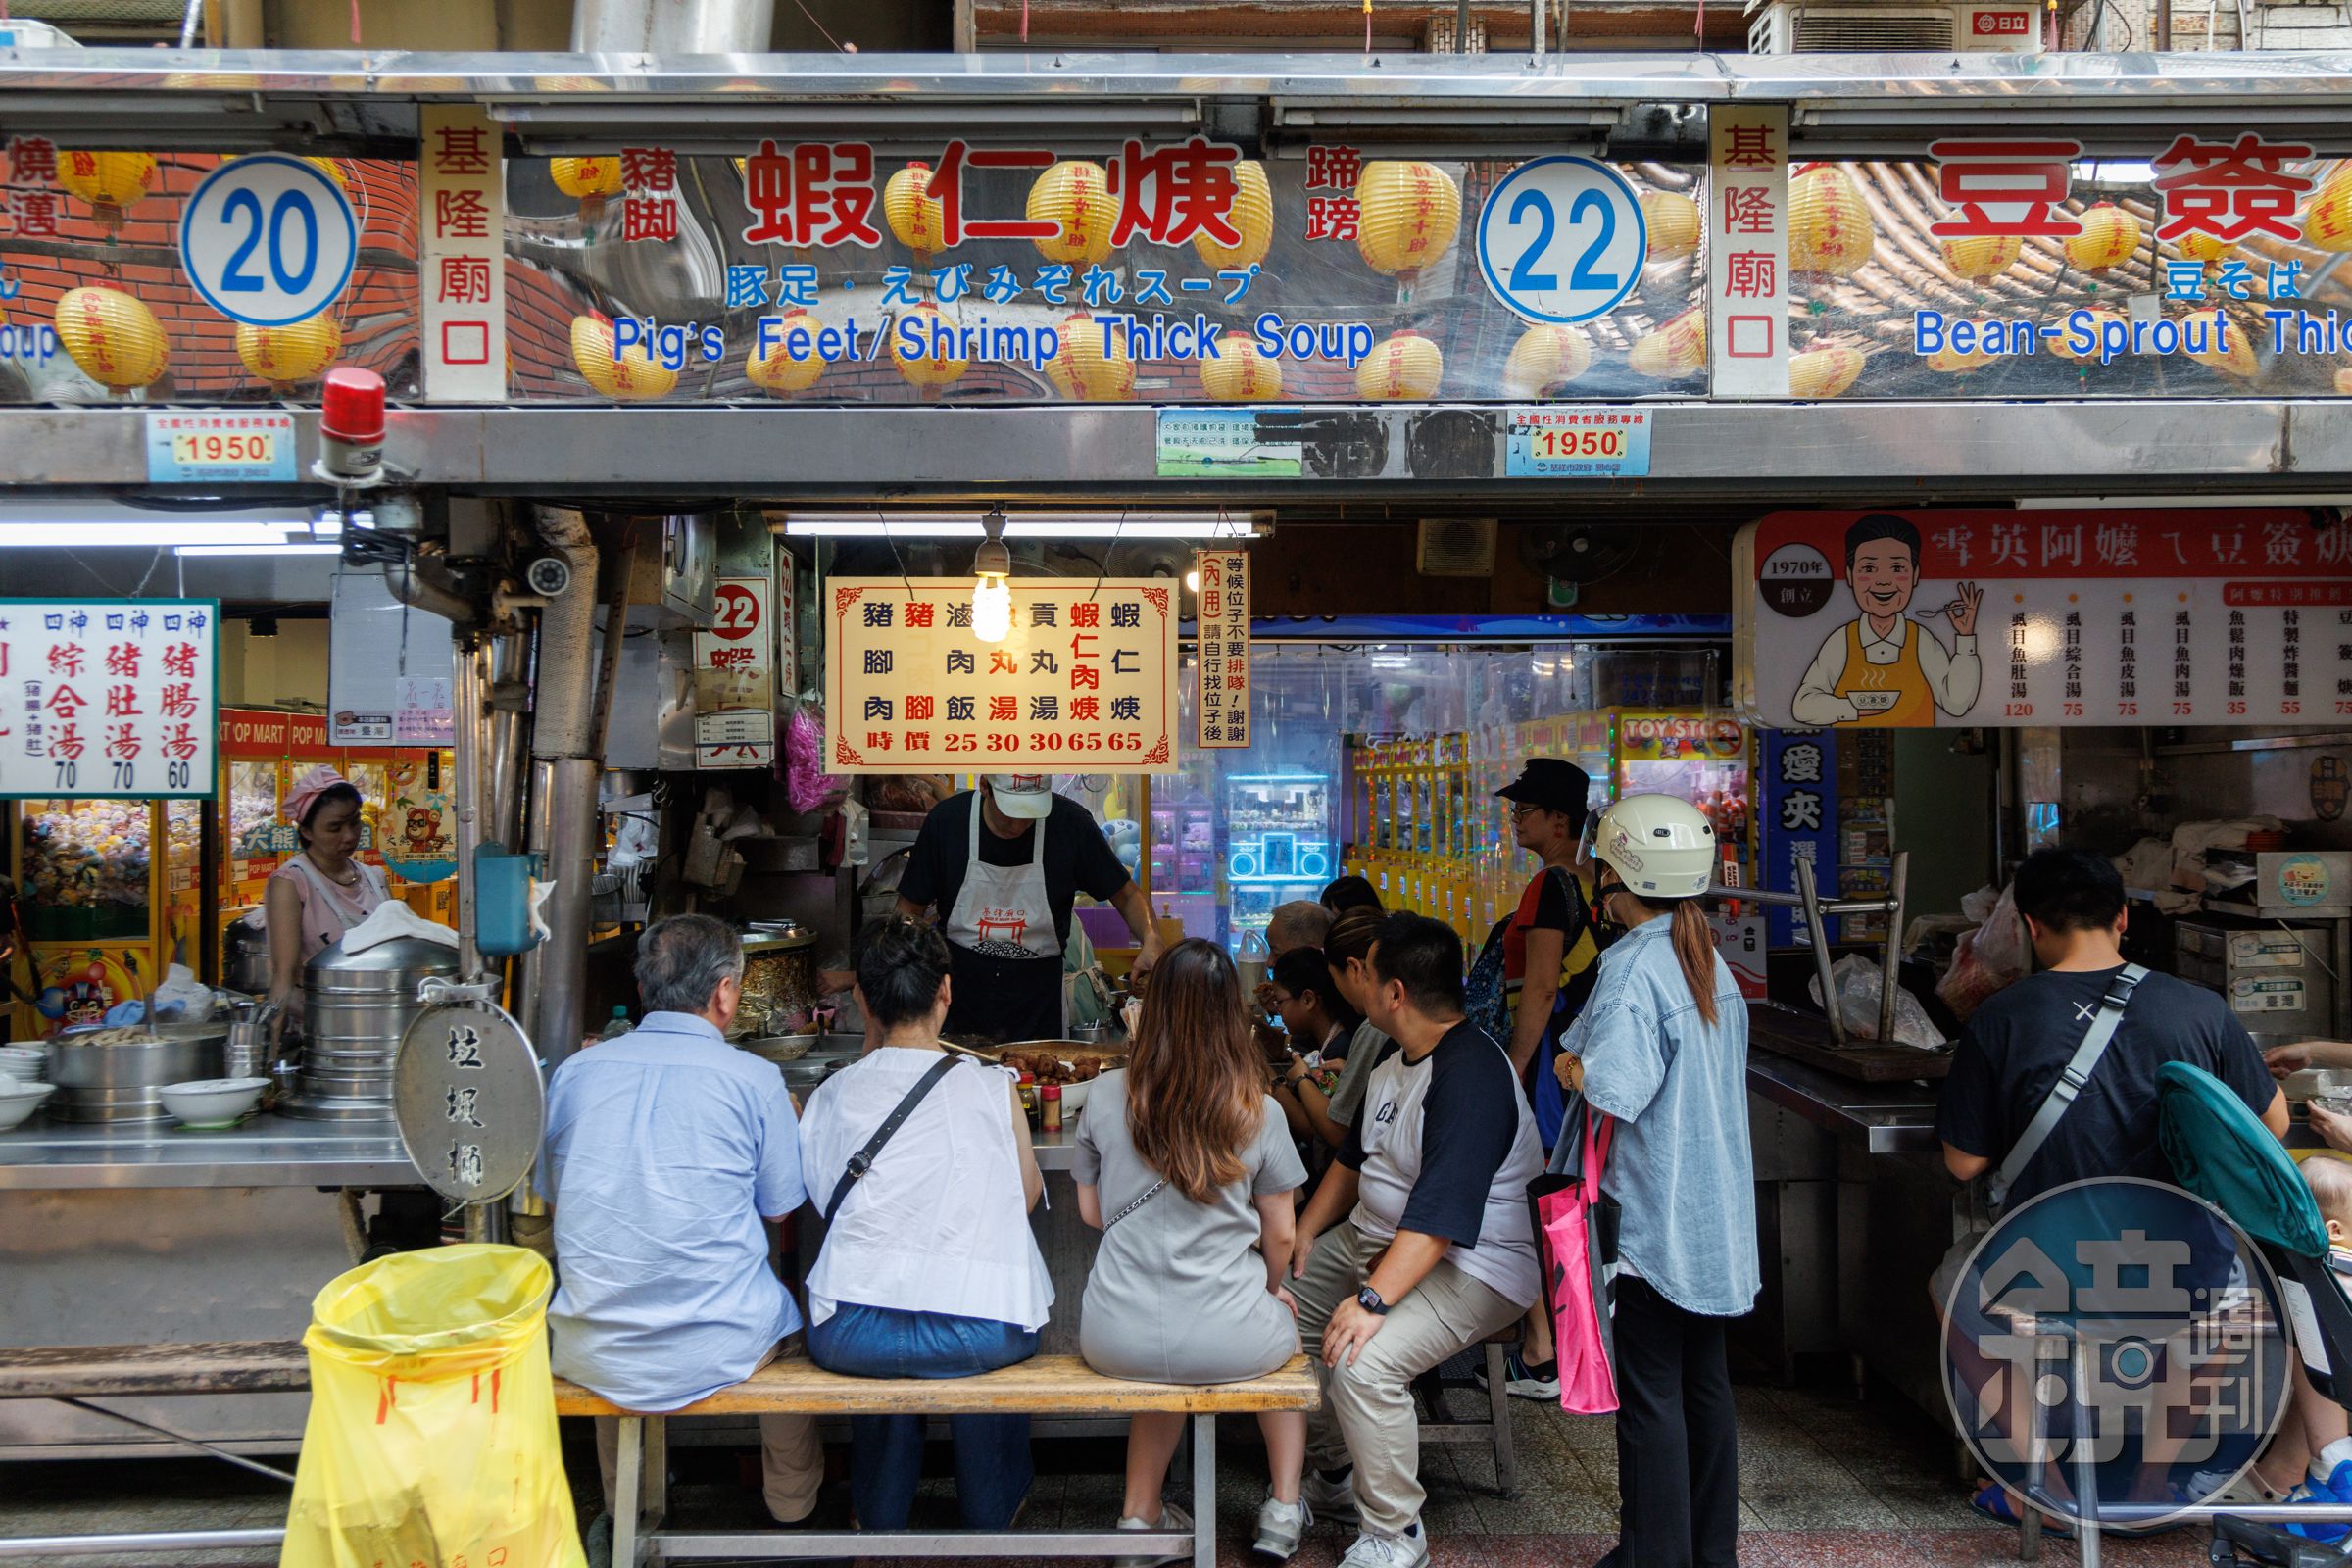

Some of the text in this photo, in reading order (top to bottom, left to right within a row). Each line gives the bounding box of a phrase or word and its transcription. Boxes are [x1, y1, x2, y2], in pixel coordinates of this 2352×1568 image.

[1999, 16, 2025, 29] 日立
[220, 187, 318, 295] 20
[434, 125, 491, 365] 基隆廟口
[1507, 187, 1618, 291] 22
[1723, 124, 1776, 358] 基隆廟口
[2165, 260, 2303, 301] 豆そば
[613, 316, 724, 370] Pig's
[758, 316, 1059, 370] Feet/Shrimp
[1094, 315, 1222, 360] Thick
[1254, 313, 1374, 369] Soup
[1915, 310, 2230, 365] Bean-Sprout
[1516, 415, 1644, 424] 全國性消費者服務專線
[186, 436, 265, 460] 1950
[1543, 431, 1617, 456] 1950
[1771, 561, 1824, 575] 1970年
[1780, 587, 1814, 604] 創立
[44, 610, 88, 637] 四神
[106, 610, 149, 638] 四神
[163, 610, 207, 639] 四神
[714, 596, 754, 628] 22
[863, 602, 894, 721] 豬腳肉
[988, 606, 1018, 721] 丸湯
[1029, 602, 1059, 721] 貢丸湯
[45, 642, 88, 789] 綜合湯 70
[105, 642, 143, 789] 豬肚湯 70
[160, 642, 200, 789] 豬腸湯 60
[2004, 703, 2034, 716] 120
[2063, 703, 2083, 716] 75
[2118, 703, 2138, 716] 75
[2172, 702, 2192, 715] 75
[2226, 702, 2246, 716] 35
[2280, 702, 2301, 716] 55
[253, 724, 285, 744] MART
[292, 726, 312, 745] POP
[866, 731, 1142, 753] 時價 25 30 30 65 65
[1626, 719, 1668, 739] TOY
[1375, 1101, 1398, 1124] GA
